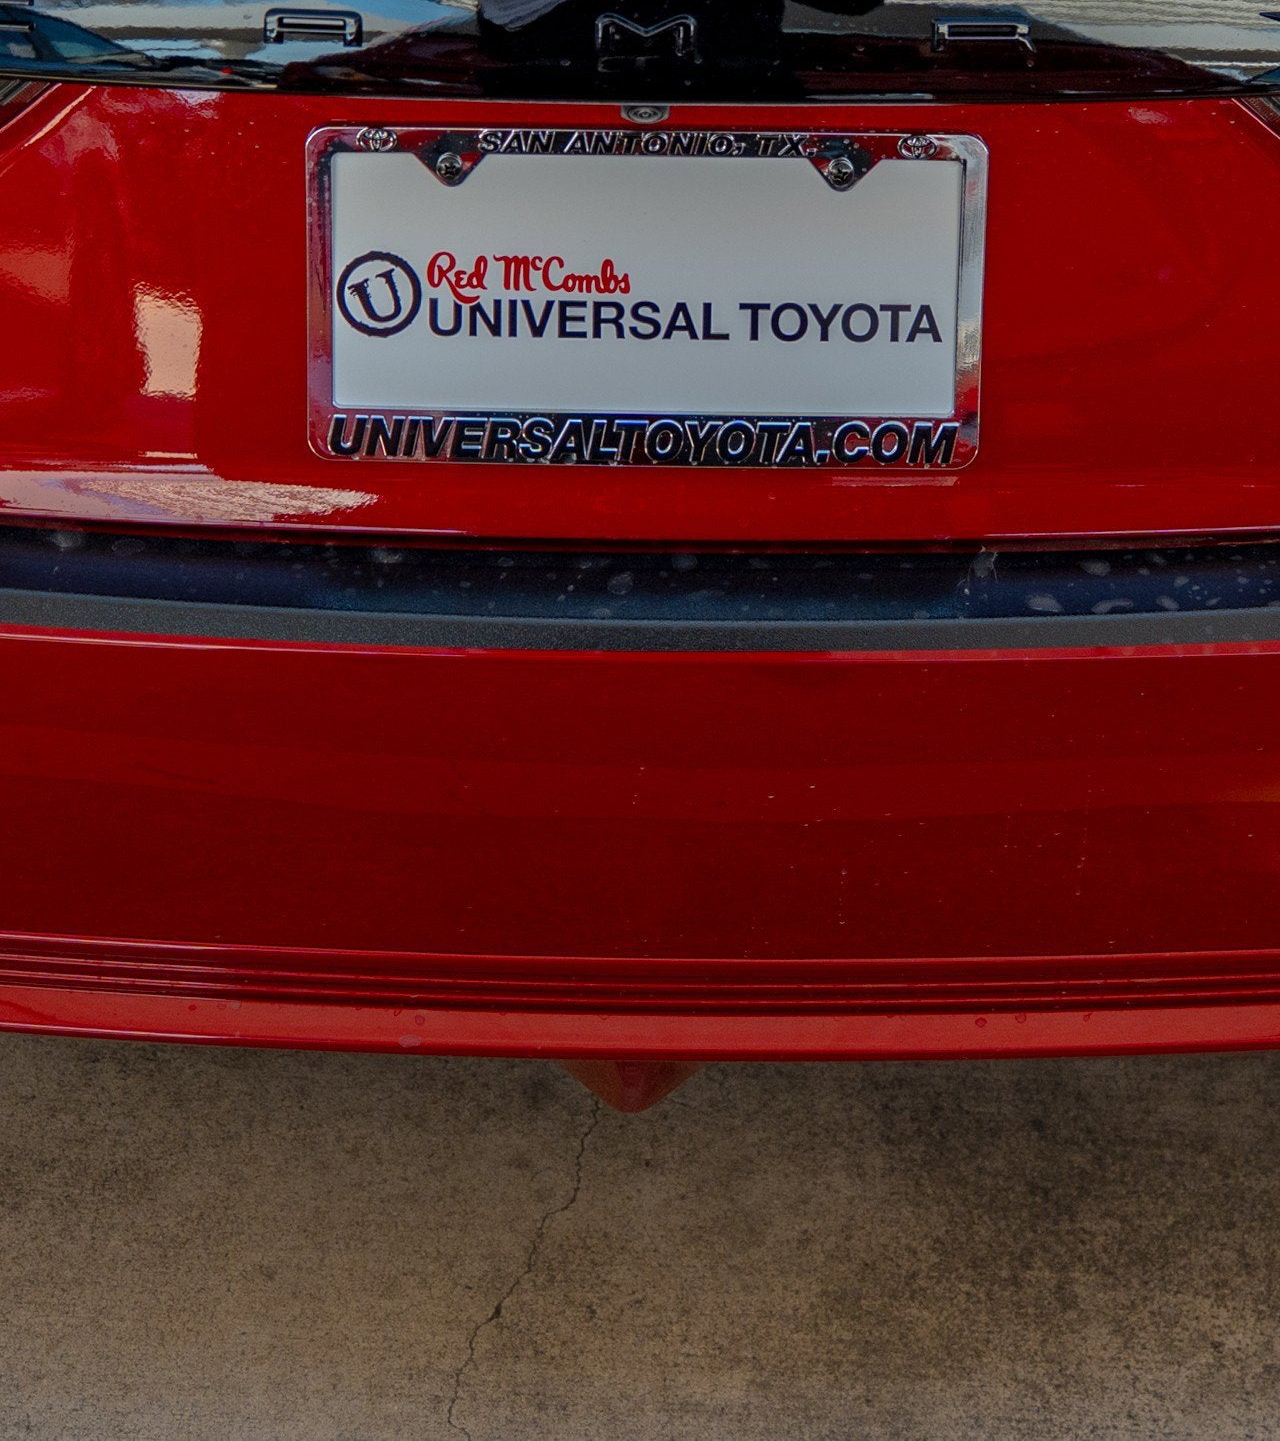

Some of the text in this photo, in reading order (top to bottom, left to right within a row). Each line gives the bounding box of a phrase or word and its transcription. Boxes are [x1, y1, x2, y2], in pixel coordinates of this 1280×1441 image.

[477, 130, 558, 156] SAN
[562, 131, 746, 158] ANTONIO,
[426, 250, 631, 305] Red McCombs
[428, 297, 943, 344] UNIVERSAL TOYOTA
[327, 415, 961, 466] UNIVERSALTOYOTA.COM
